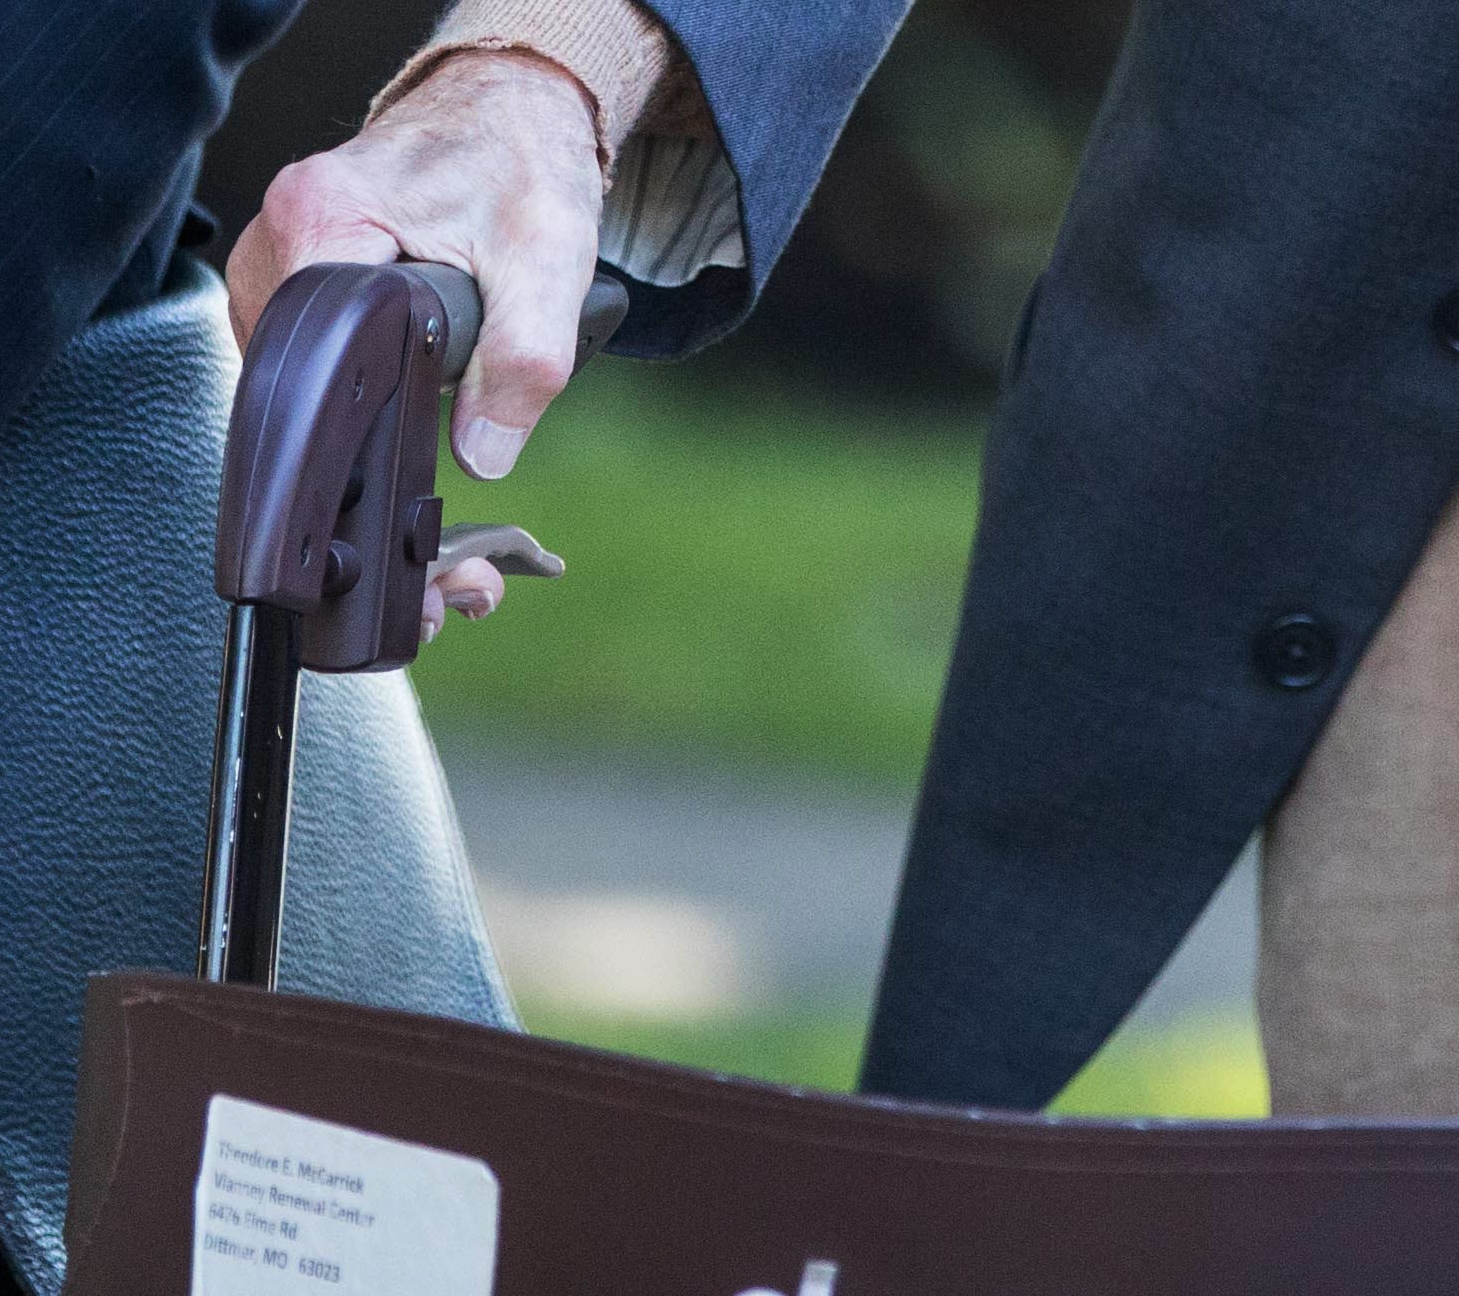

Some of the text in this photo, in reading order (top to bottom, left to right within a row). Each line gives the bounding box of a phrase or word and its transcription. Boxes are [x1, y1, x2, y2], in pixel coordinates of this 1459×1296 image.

[219, 1141, 279, 1173] Theodore
[298, 1161, 365, 1194] McCarrick
[269, 1185, 326, 1216] Renewal
[330, 1200, 376, 1228] Center
[280, 1219, 298, 1241] Rd
[263, 1247, 289, 1270] MO
[299, 1257, 340, 1283] 63023
